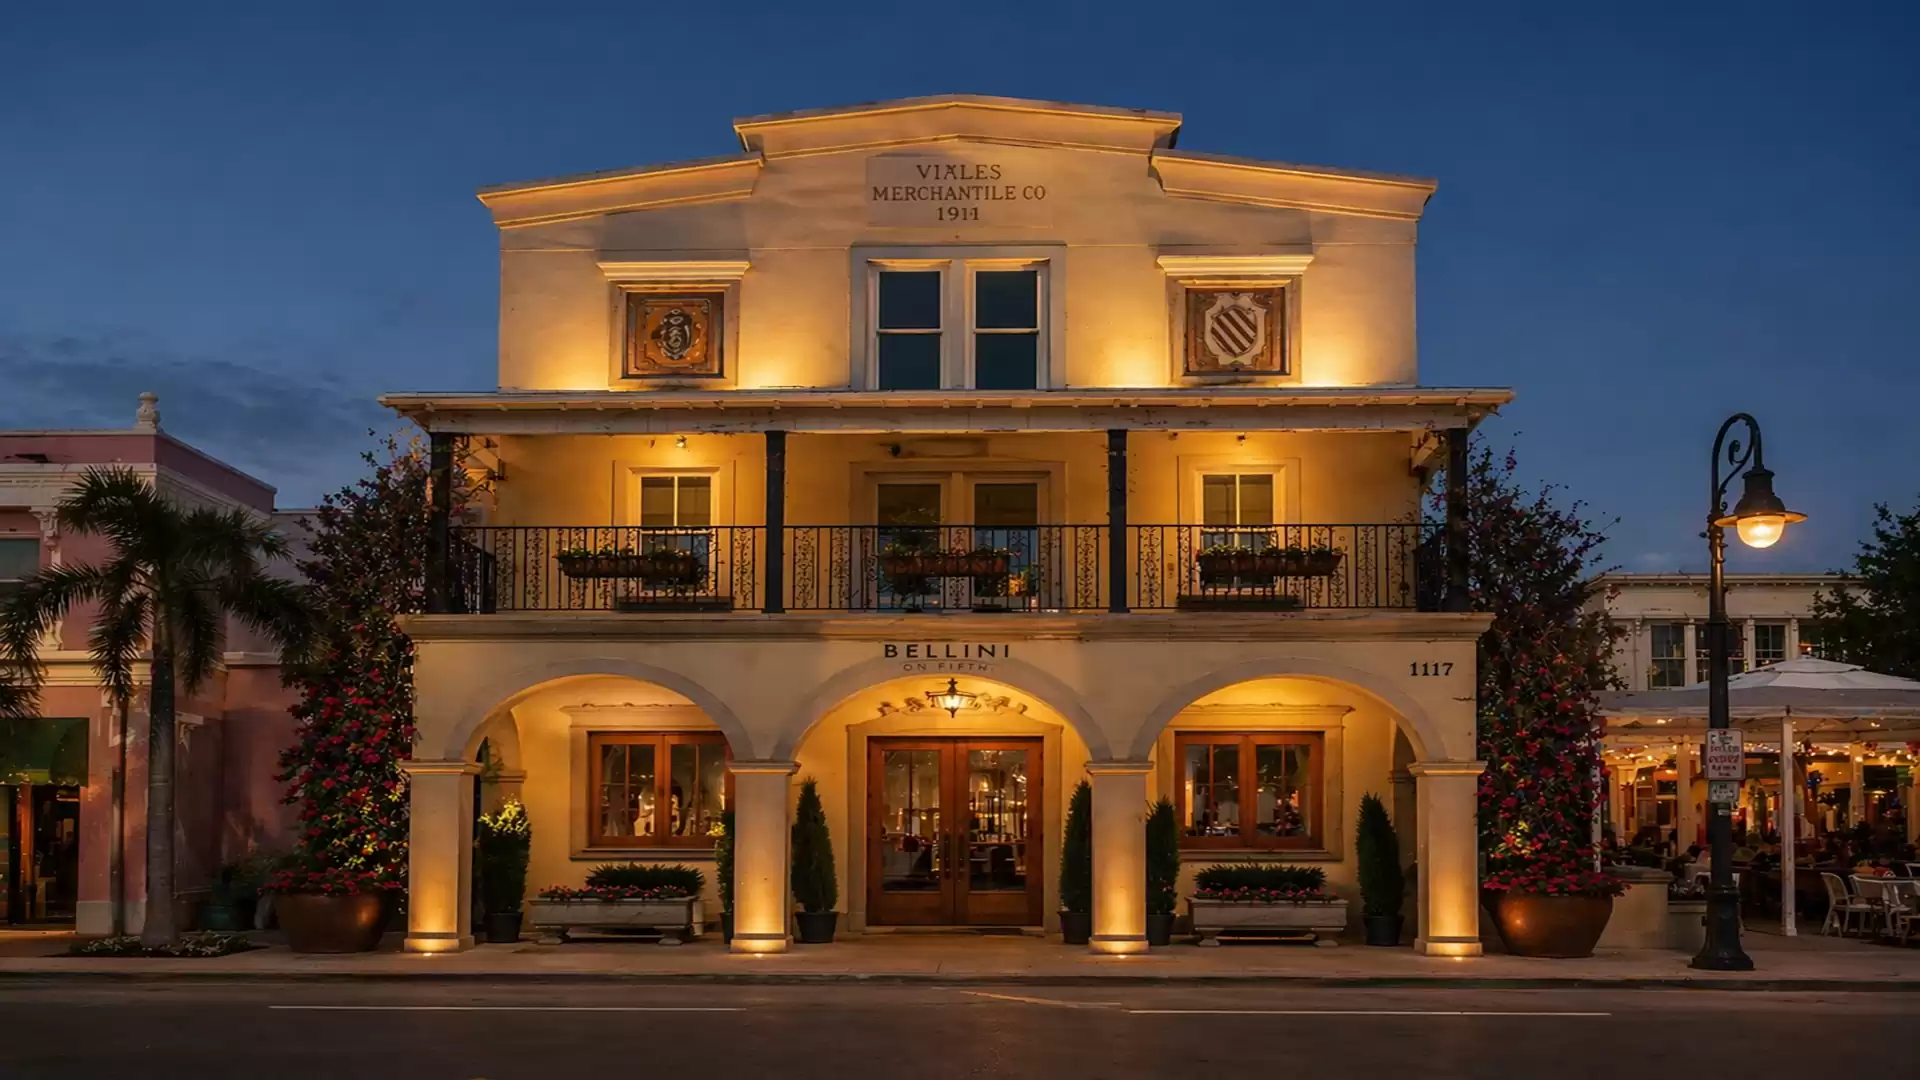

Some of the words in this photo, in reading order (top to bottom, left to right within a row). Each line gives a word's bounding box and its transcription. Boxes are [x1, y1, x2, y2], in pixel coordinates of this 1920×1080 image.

[872, 185, 1017, 202] MERCHANTILE
[1022, 185, 1047, 201] CO
[937, 206, 980, 222] 1911
[884, 643, 1009, 659] BELLINI
[903, 662, 927, 672] ON
[938, 662, 988, 672] FIFTH
[1409, 661, 1455, 677] 1117
